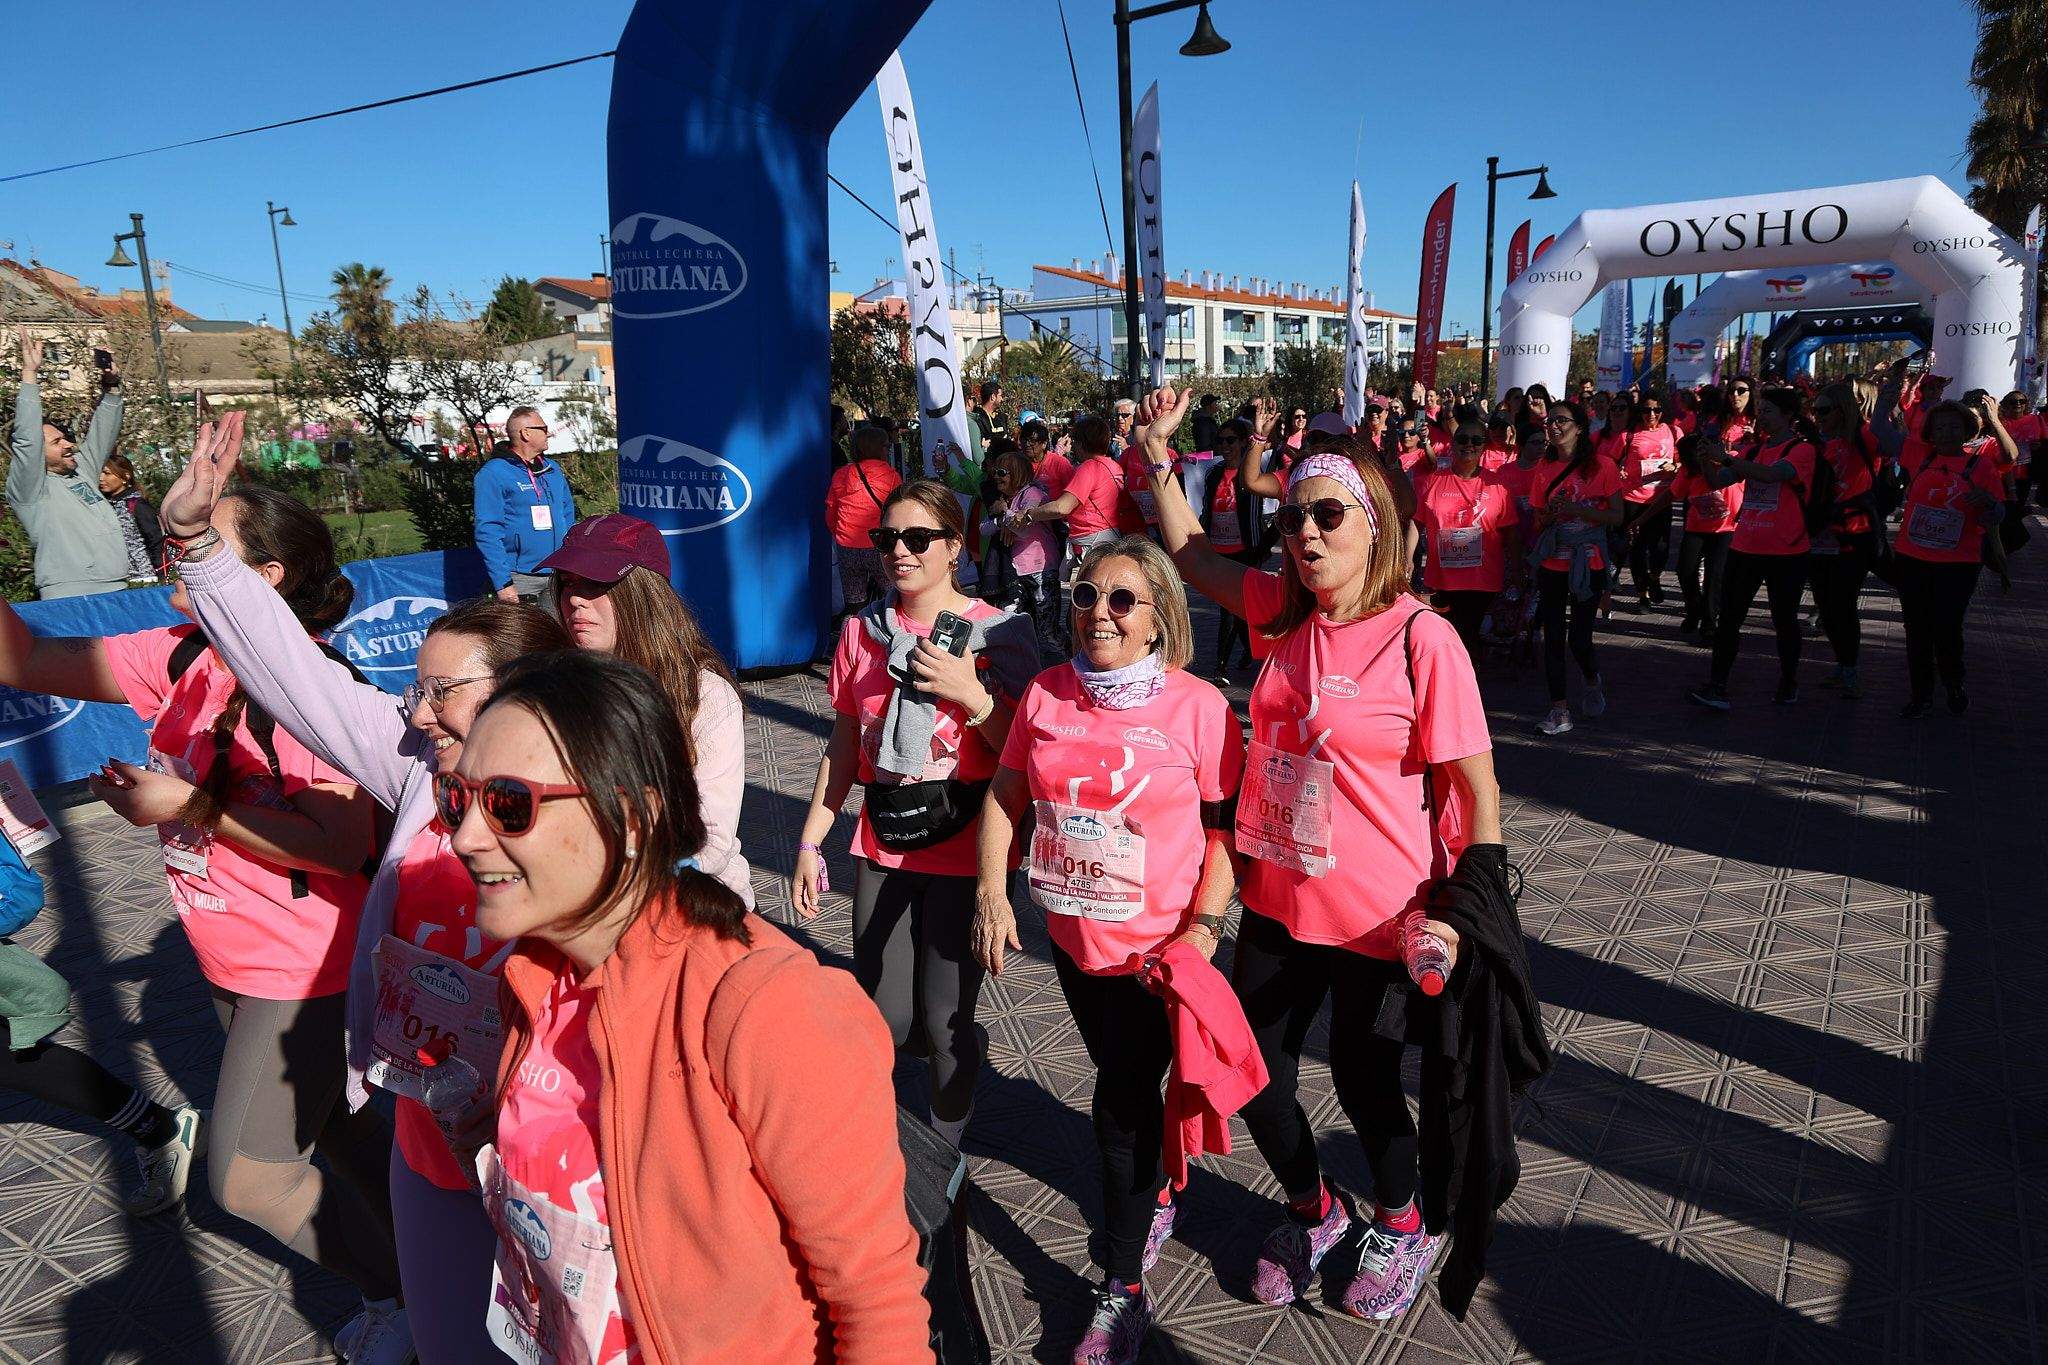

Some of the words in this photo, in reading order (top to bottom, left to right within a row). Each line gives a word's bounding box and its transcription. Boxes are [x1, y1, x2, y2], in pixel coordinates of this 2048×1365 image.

[1640, 204, 1848, 257] OYSHO
[1913, 236, 1984, 254] OYSHO
[656, 247, 723, 259] LECHERA
[613, 264, 732, 293] STURIANA
[1528, 269, 1582, 284] OYSHO
[1813, 315, 1902, 327] VOLVO
[1945, 321, 2012, 337] OYSHO
[1502, 343, 1551, 356] OYSHO
[662, 469, 728, 481] LECHERA
[619, 481, 737, 510] STURIANA
[366, 621, 413, 635] CENTRAL
[1039, 722, 1087, 737] OYSHO
[1260, 798, 1294, 824] 016
[1063, 822, 1103, 837] ASTURIANA
[1237, 836, 1263, 853] OYSHO
[1063, 857, 1105, 878] 016
[1041, 882, 1062, 893] CARRERA
[1071, 879, 1091, 889] 4785
[195, 893, 227, 912] MUJER
[1040, 894, 1072, 908] OYSHO
[1093, 905, 1130, 915] Santander
[414, 968, 467, 1003] ASTURIANA
[369, 1061, 404, 1083] YSHO
[519, 1061, 560, 1092] SHO
